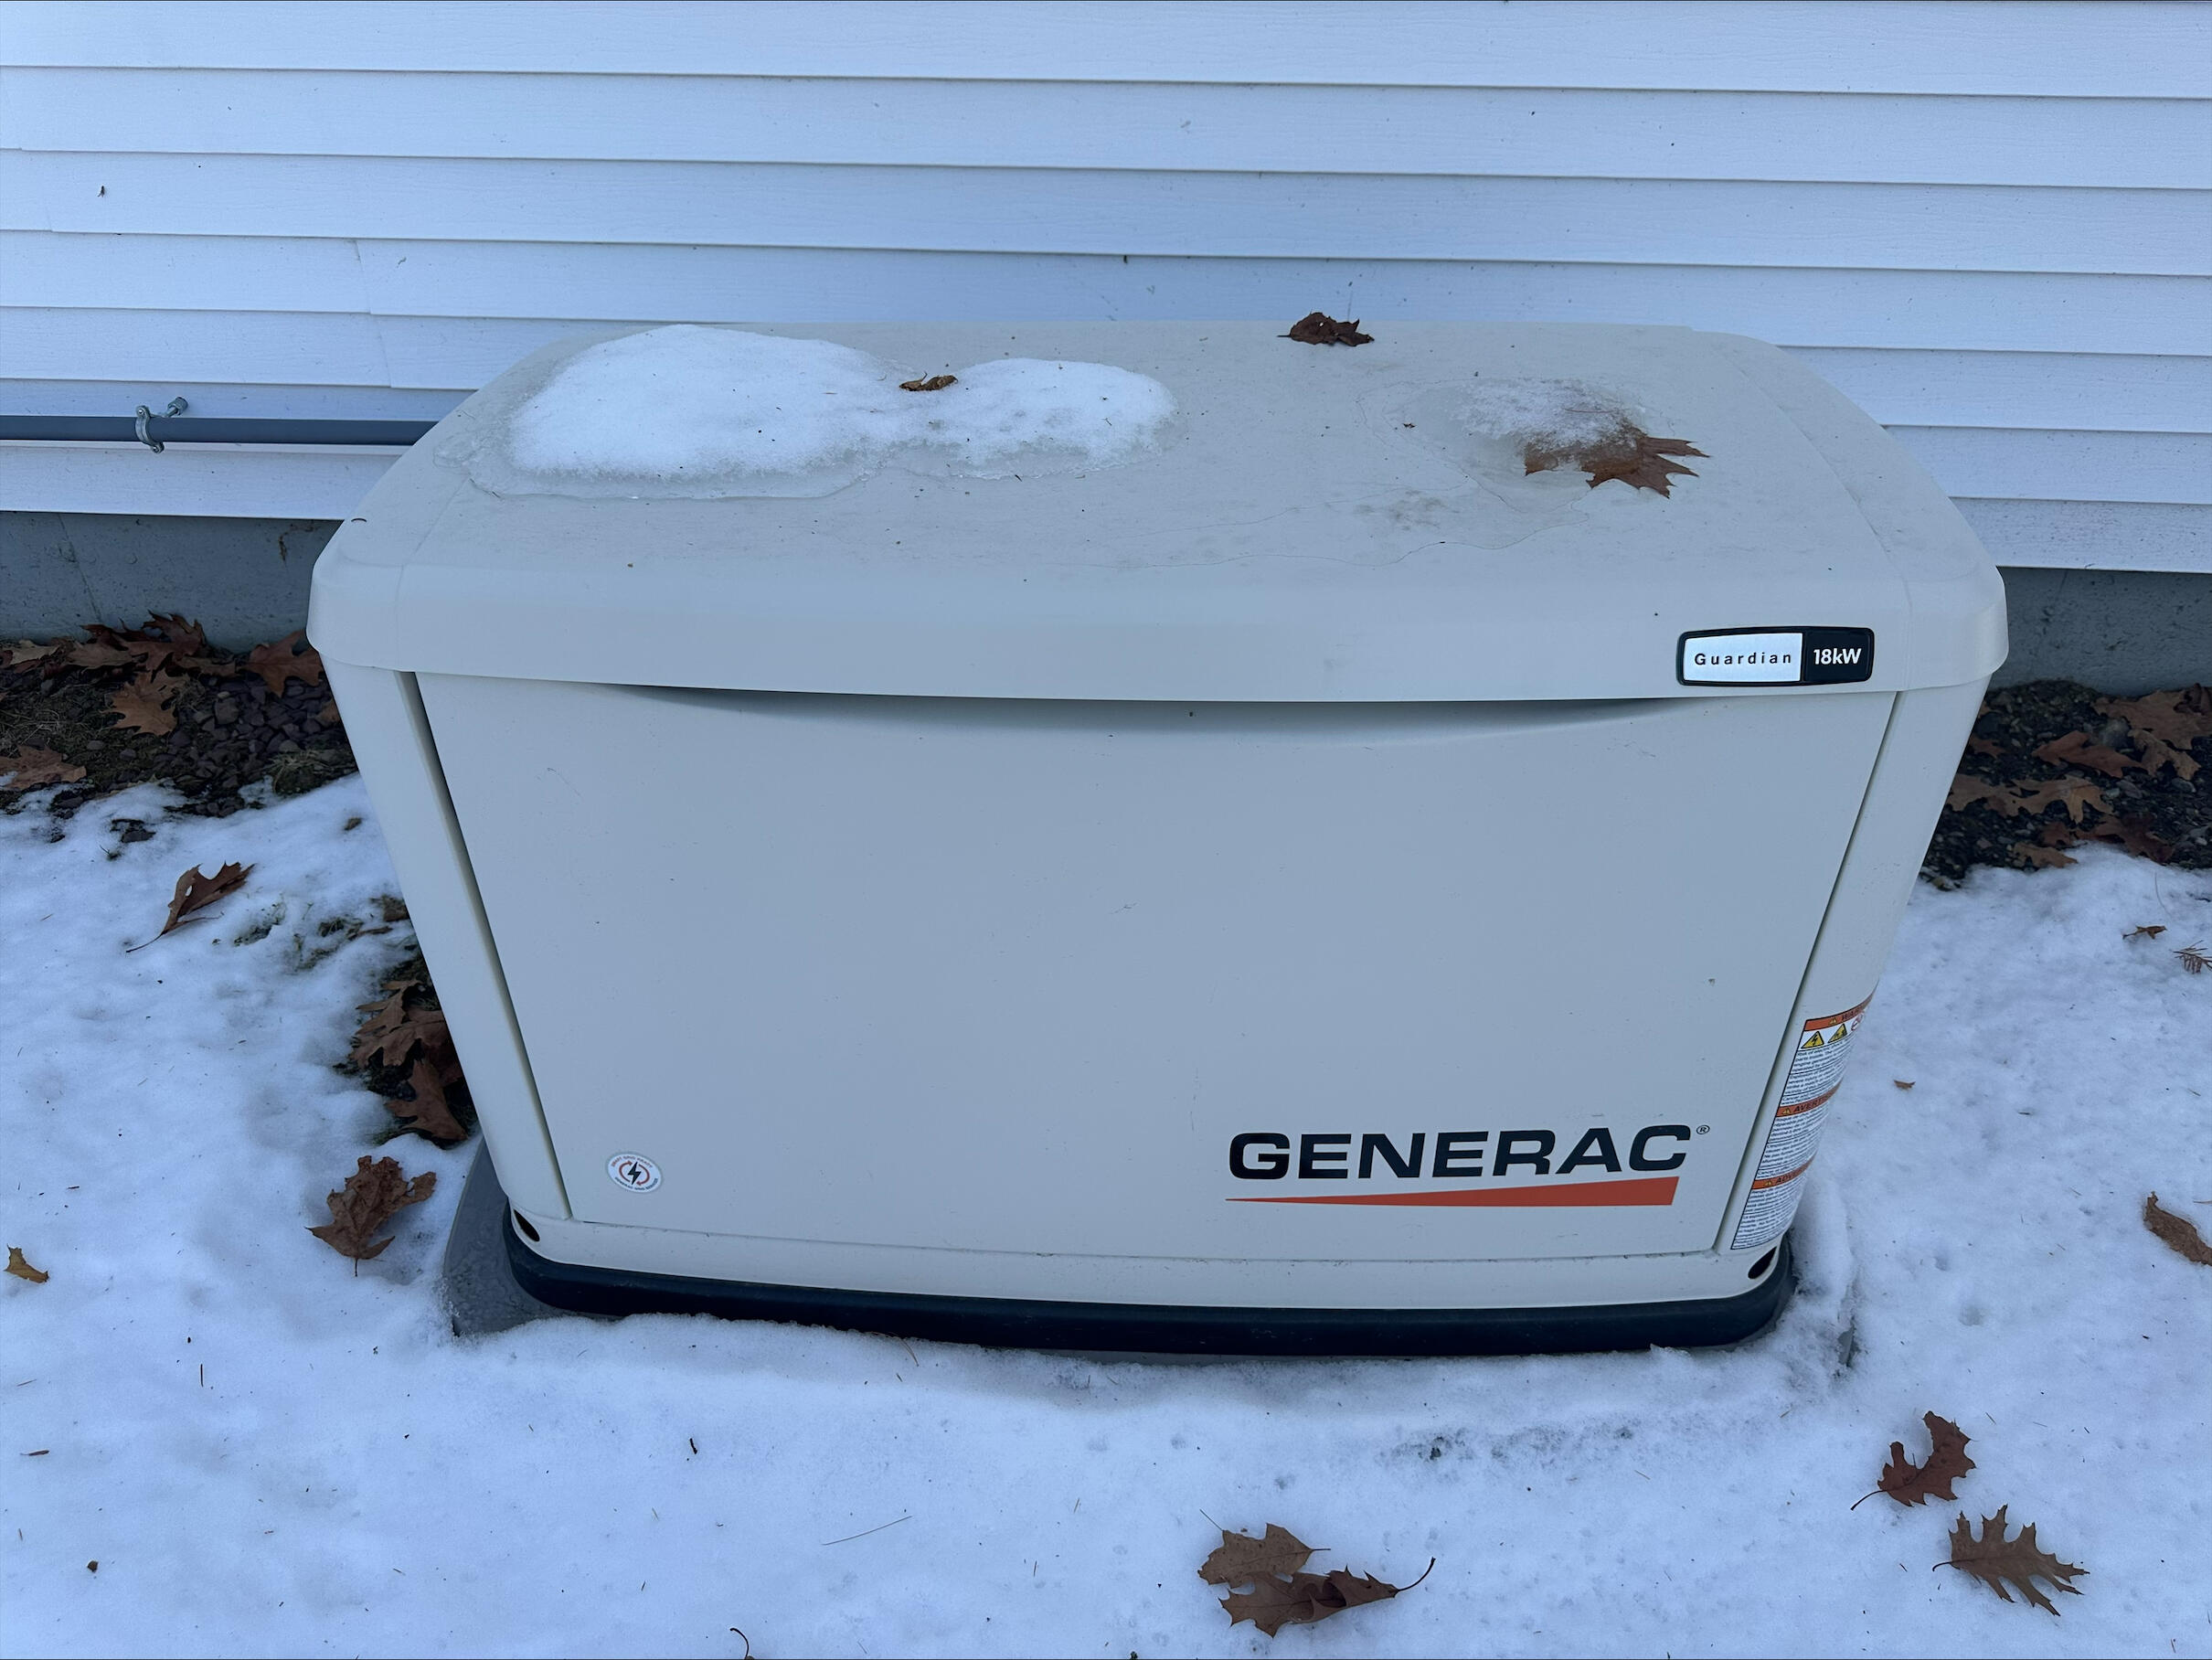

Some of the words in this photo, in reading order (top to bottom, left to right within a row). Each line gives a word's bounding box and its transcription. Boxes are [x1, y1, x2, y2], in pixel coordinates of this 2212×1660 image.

[1694, 652, 1792, 665] Guardian
[1813, 648, 1863, 665] 18kW
[1228, 1124, 1691, 1180] GENERAC
